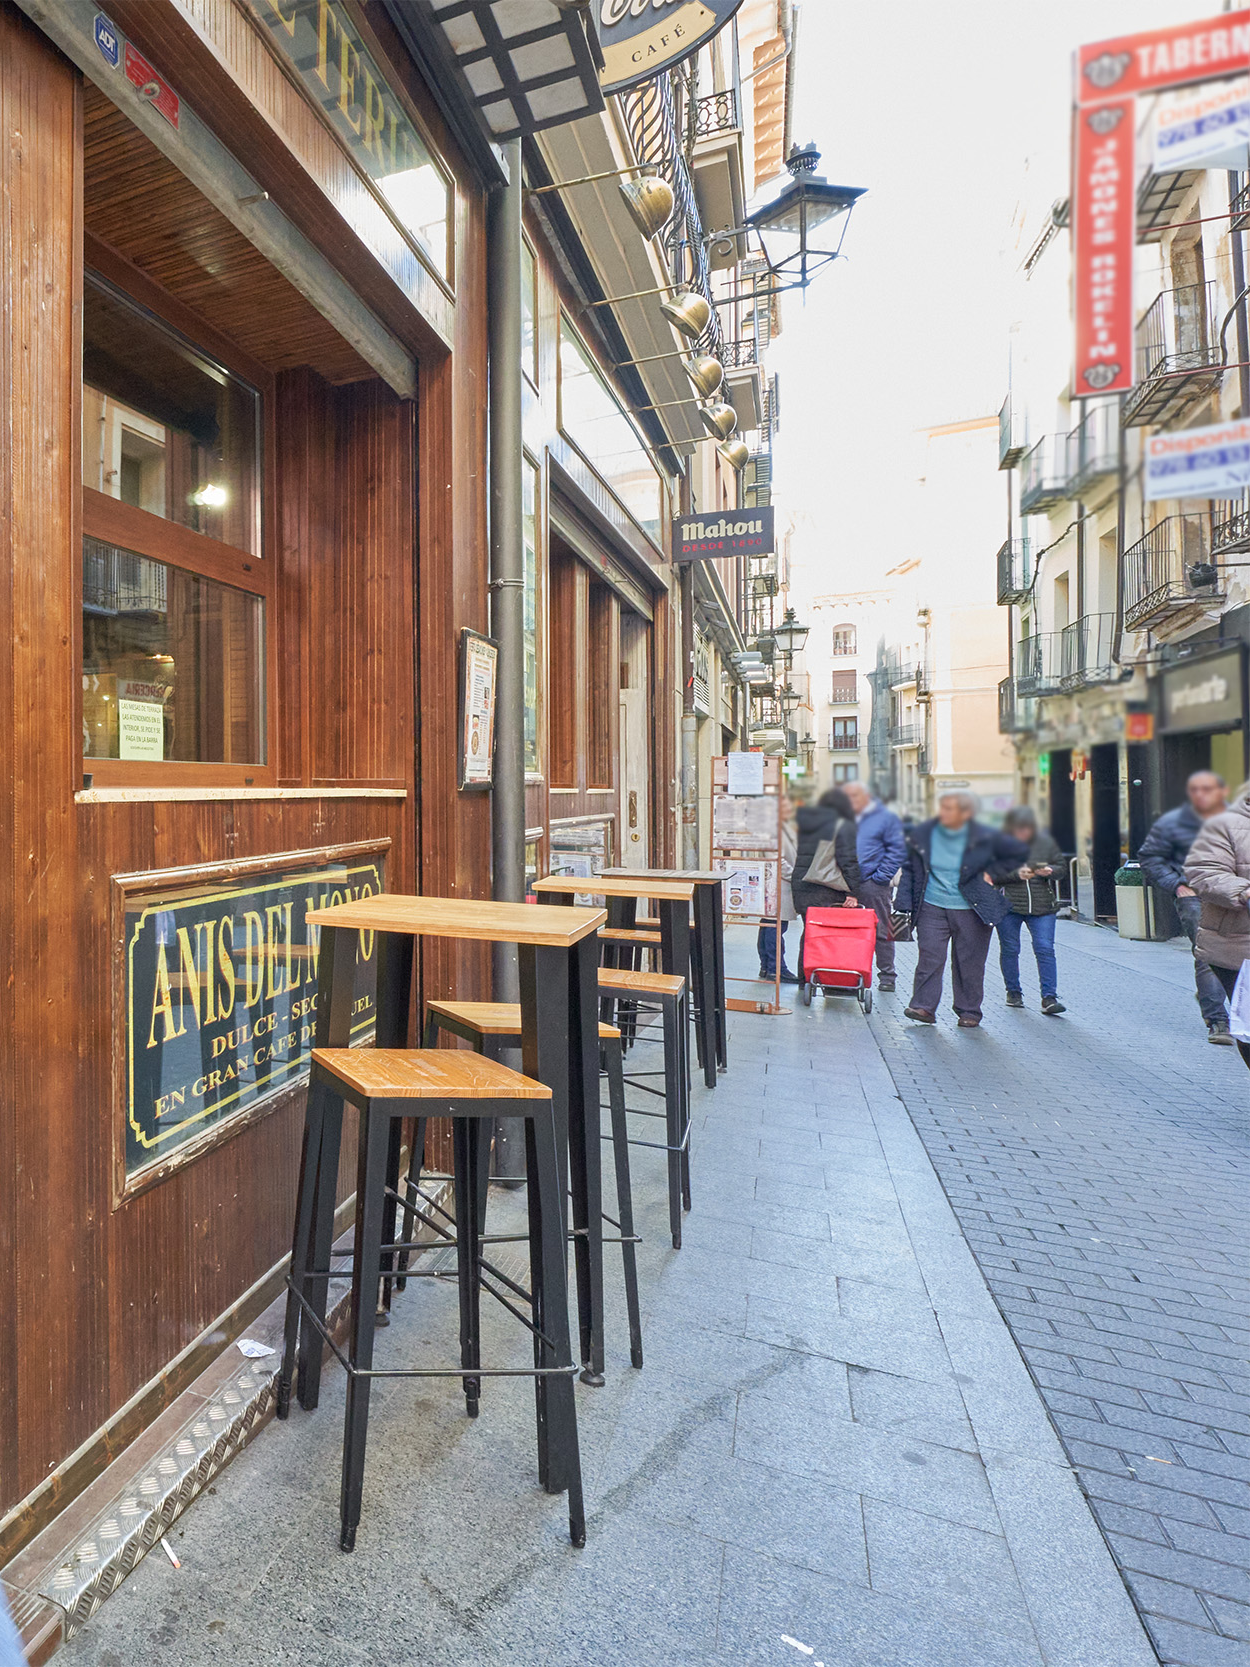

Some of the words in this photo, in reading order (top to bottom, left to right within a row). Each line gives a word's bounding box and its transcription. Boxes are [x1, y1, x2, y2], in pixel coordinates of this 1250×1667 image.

[98, 28, 117, 53] ADT
[631, 23, 686, 63] CAFÉ
[1089, 138, 1120, 245] JAMONES
[680, 518, 764, 541] Mahou
[682, 541, 724, 553] DESDE
[732, 537, 762, 548] 1890
[147, 914, 236, 1049] ANIS
[243, 901, 301, 1009] DEL
[305, 883, 374, 984] MO
[210, 1011, 279, 1059] DULCE
[154, 1086, 186, 1119] EN
[191, 1055, 250, 1097] GRAN
[253, 1030, 297, 1066] CAFE
